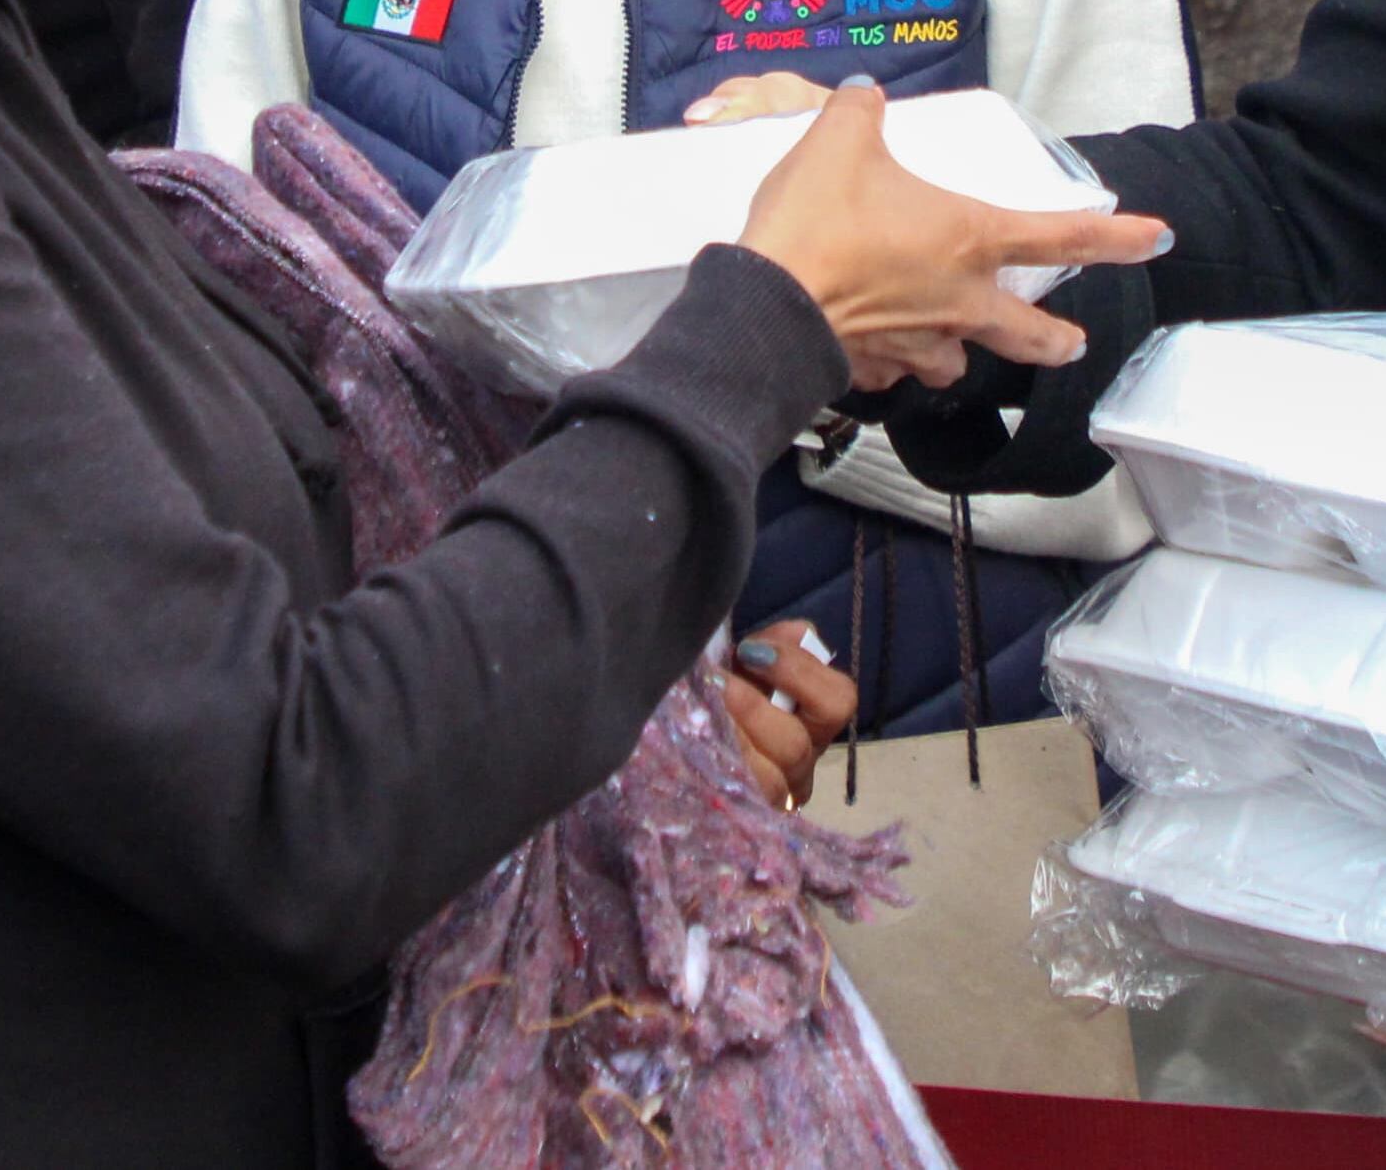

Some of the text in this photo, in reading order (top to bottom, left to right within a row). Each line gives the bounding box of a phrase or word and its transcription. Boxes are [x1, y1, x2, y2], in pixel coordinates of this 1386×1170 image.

[716, 18, 958, 52] EL PODER EN TUS MANOS
